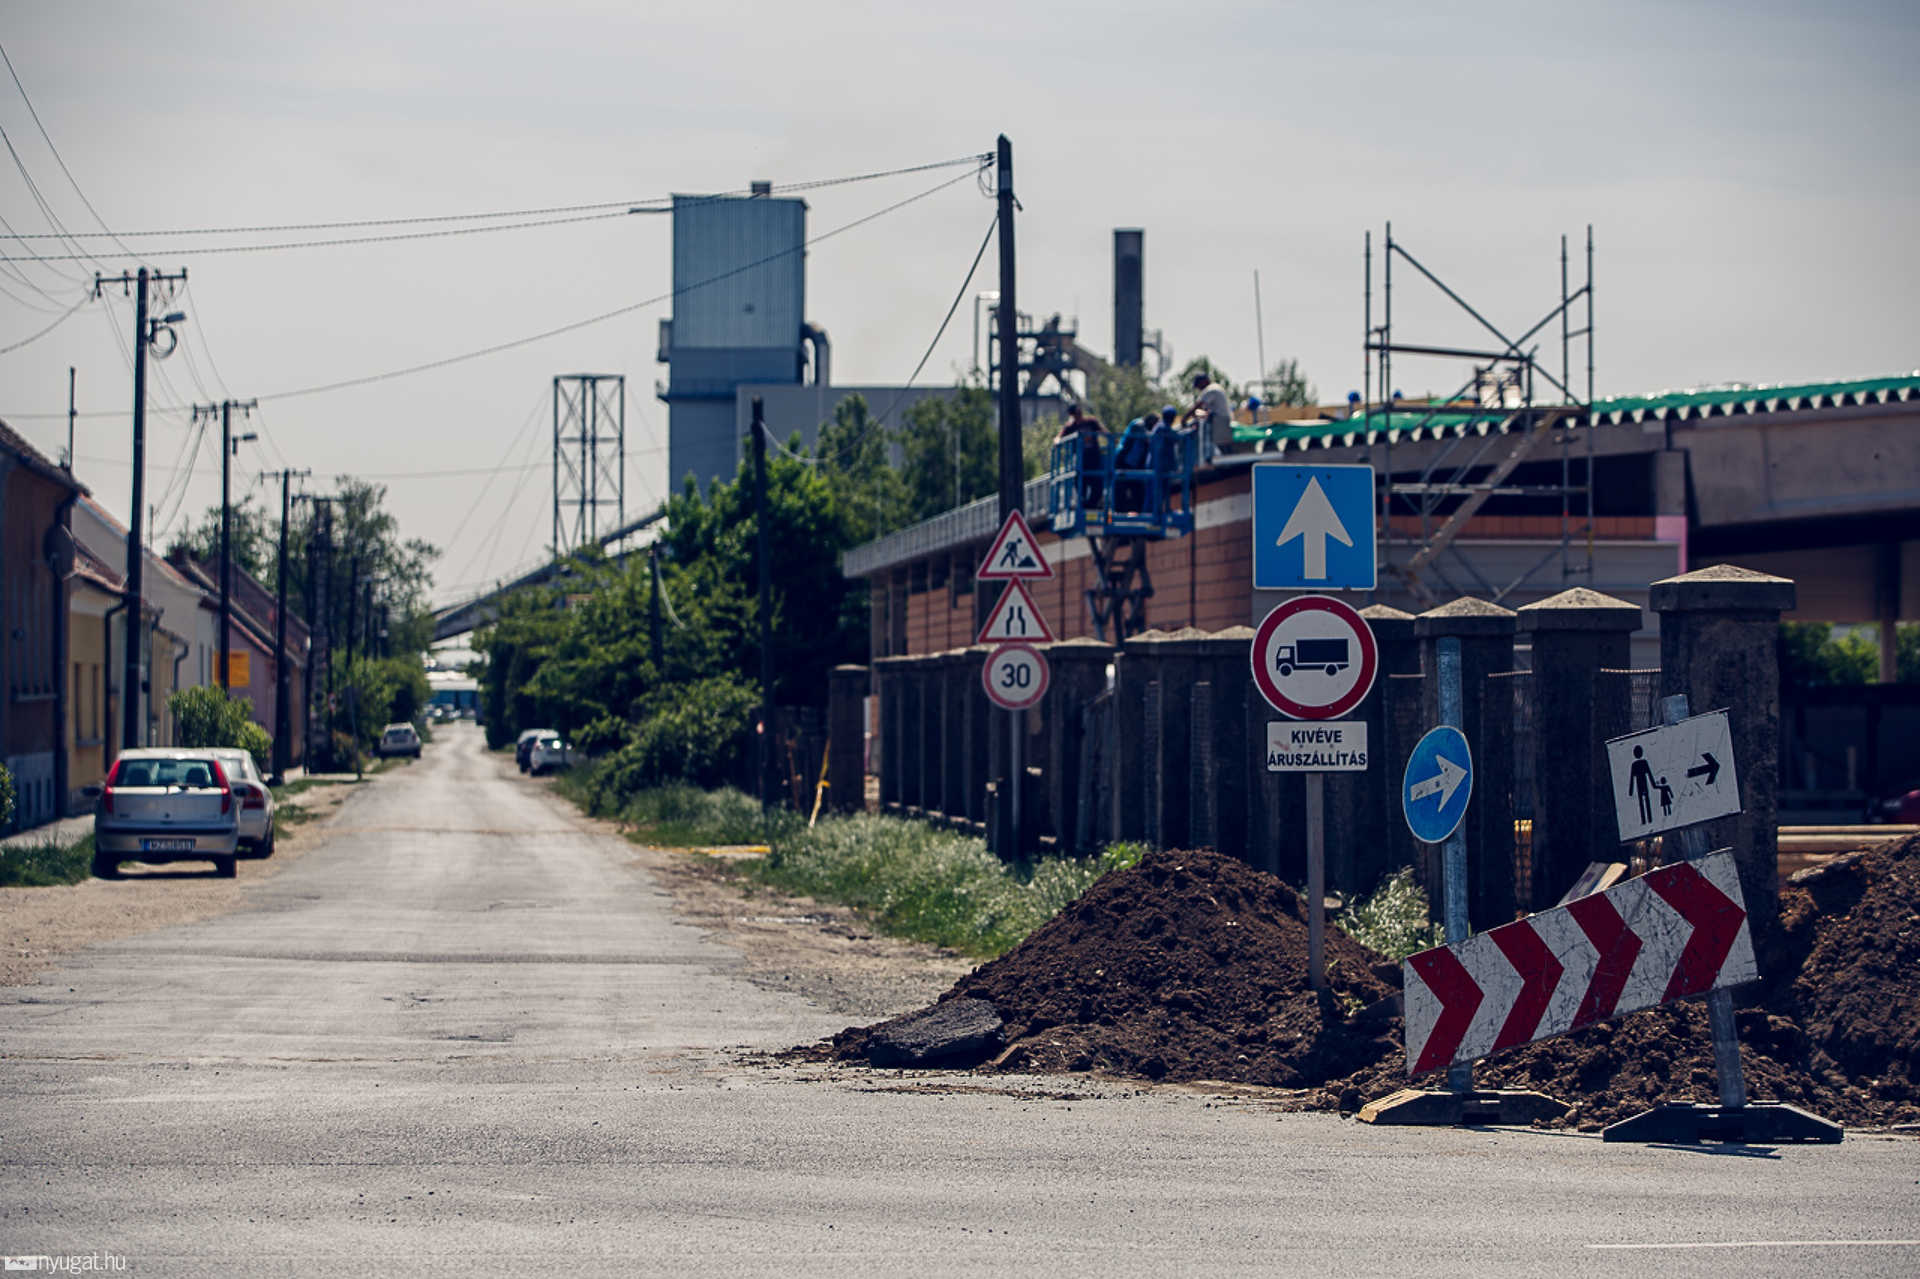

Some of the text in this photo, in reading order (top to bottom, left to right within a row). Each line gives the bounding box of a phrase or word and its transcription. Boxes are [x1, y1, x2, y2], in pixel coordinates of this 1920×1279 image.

[1001, 663, 1031, 688] 30
[1291, 727, 1342, 743] KIVÉVE
[1268, 750, 1366, 766] ÁRUSZÁLLÍTÁS
